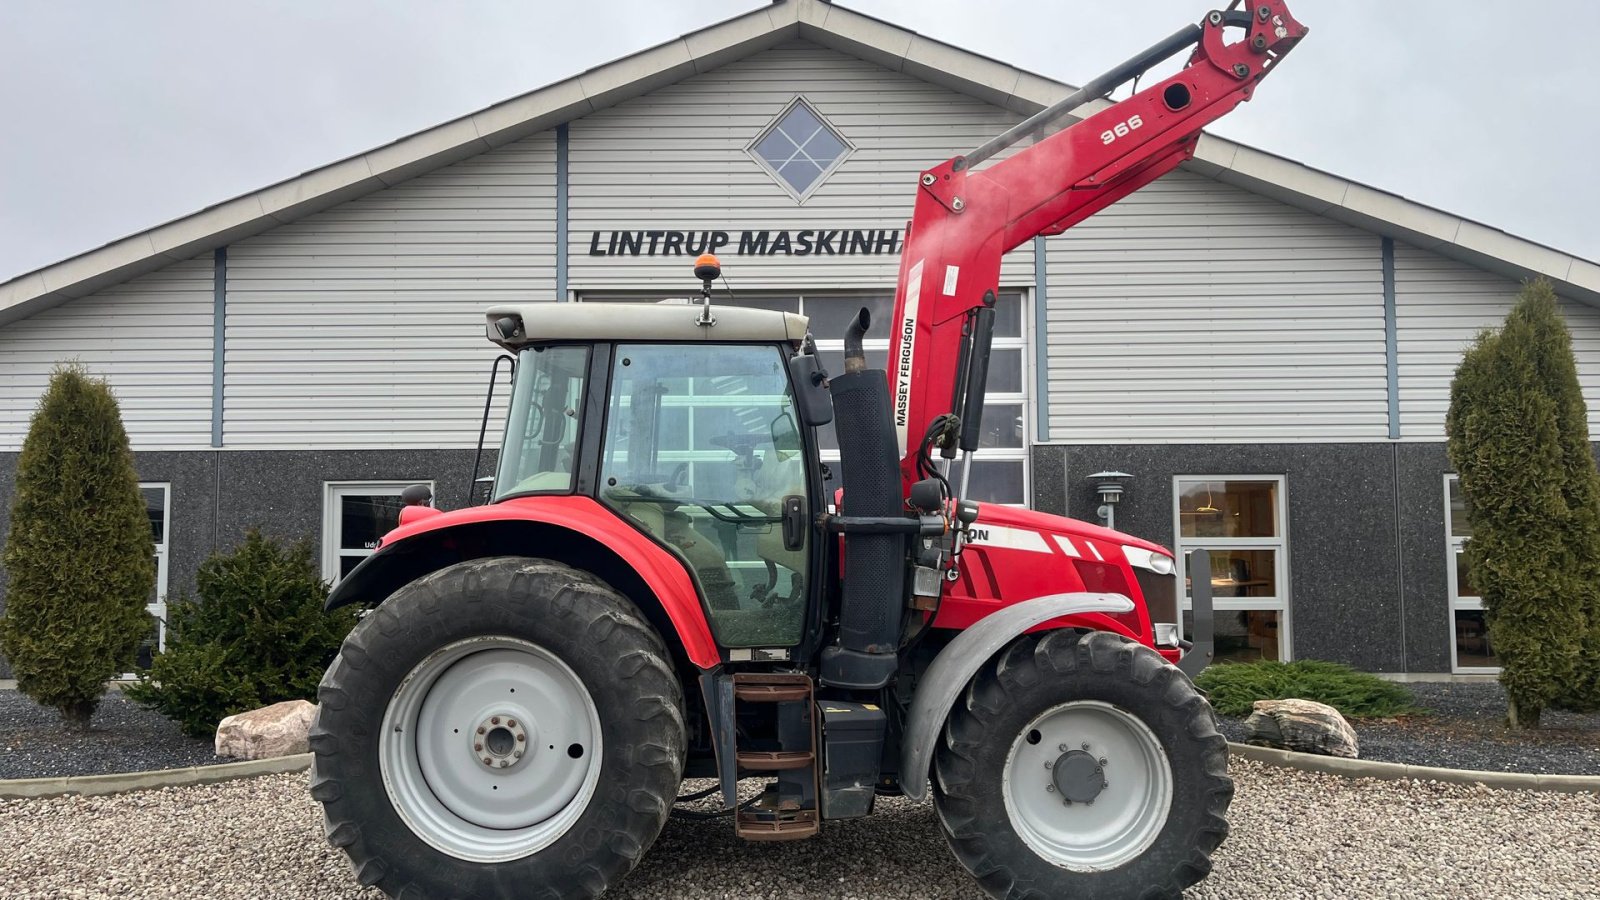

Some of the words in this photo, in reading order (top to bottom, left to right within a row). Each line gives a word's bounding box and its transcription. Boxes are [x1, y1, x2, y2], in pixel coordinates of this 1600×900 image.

[1100, 114, 1144, 146] 966
[589, 230, 729, 257] LINTRUP
[737, 229, 903, 256] MASKINH
[900, 318, 915, 378] FERGUSON
[896, 381, 909, 427] MASSEY
